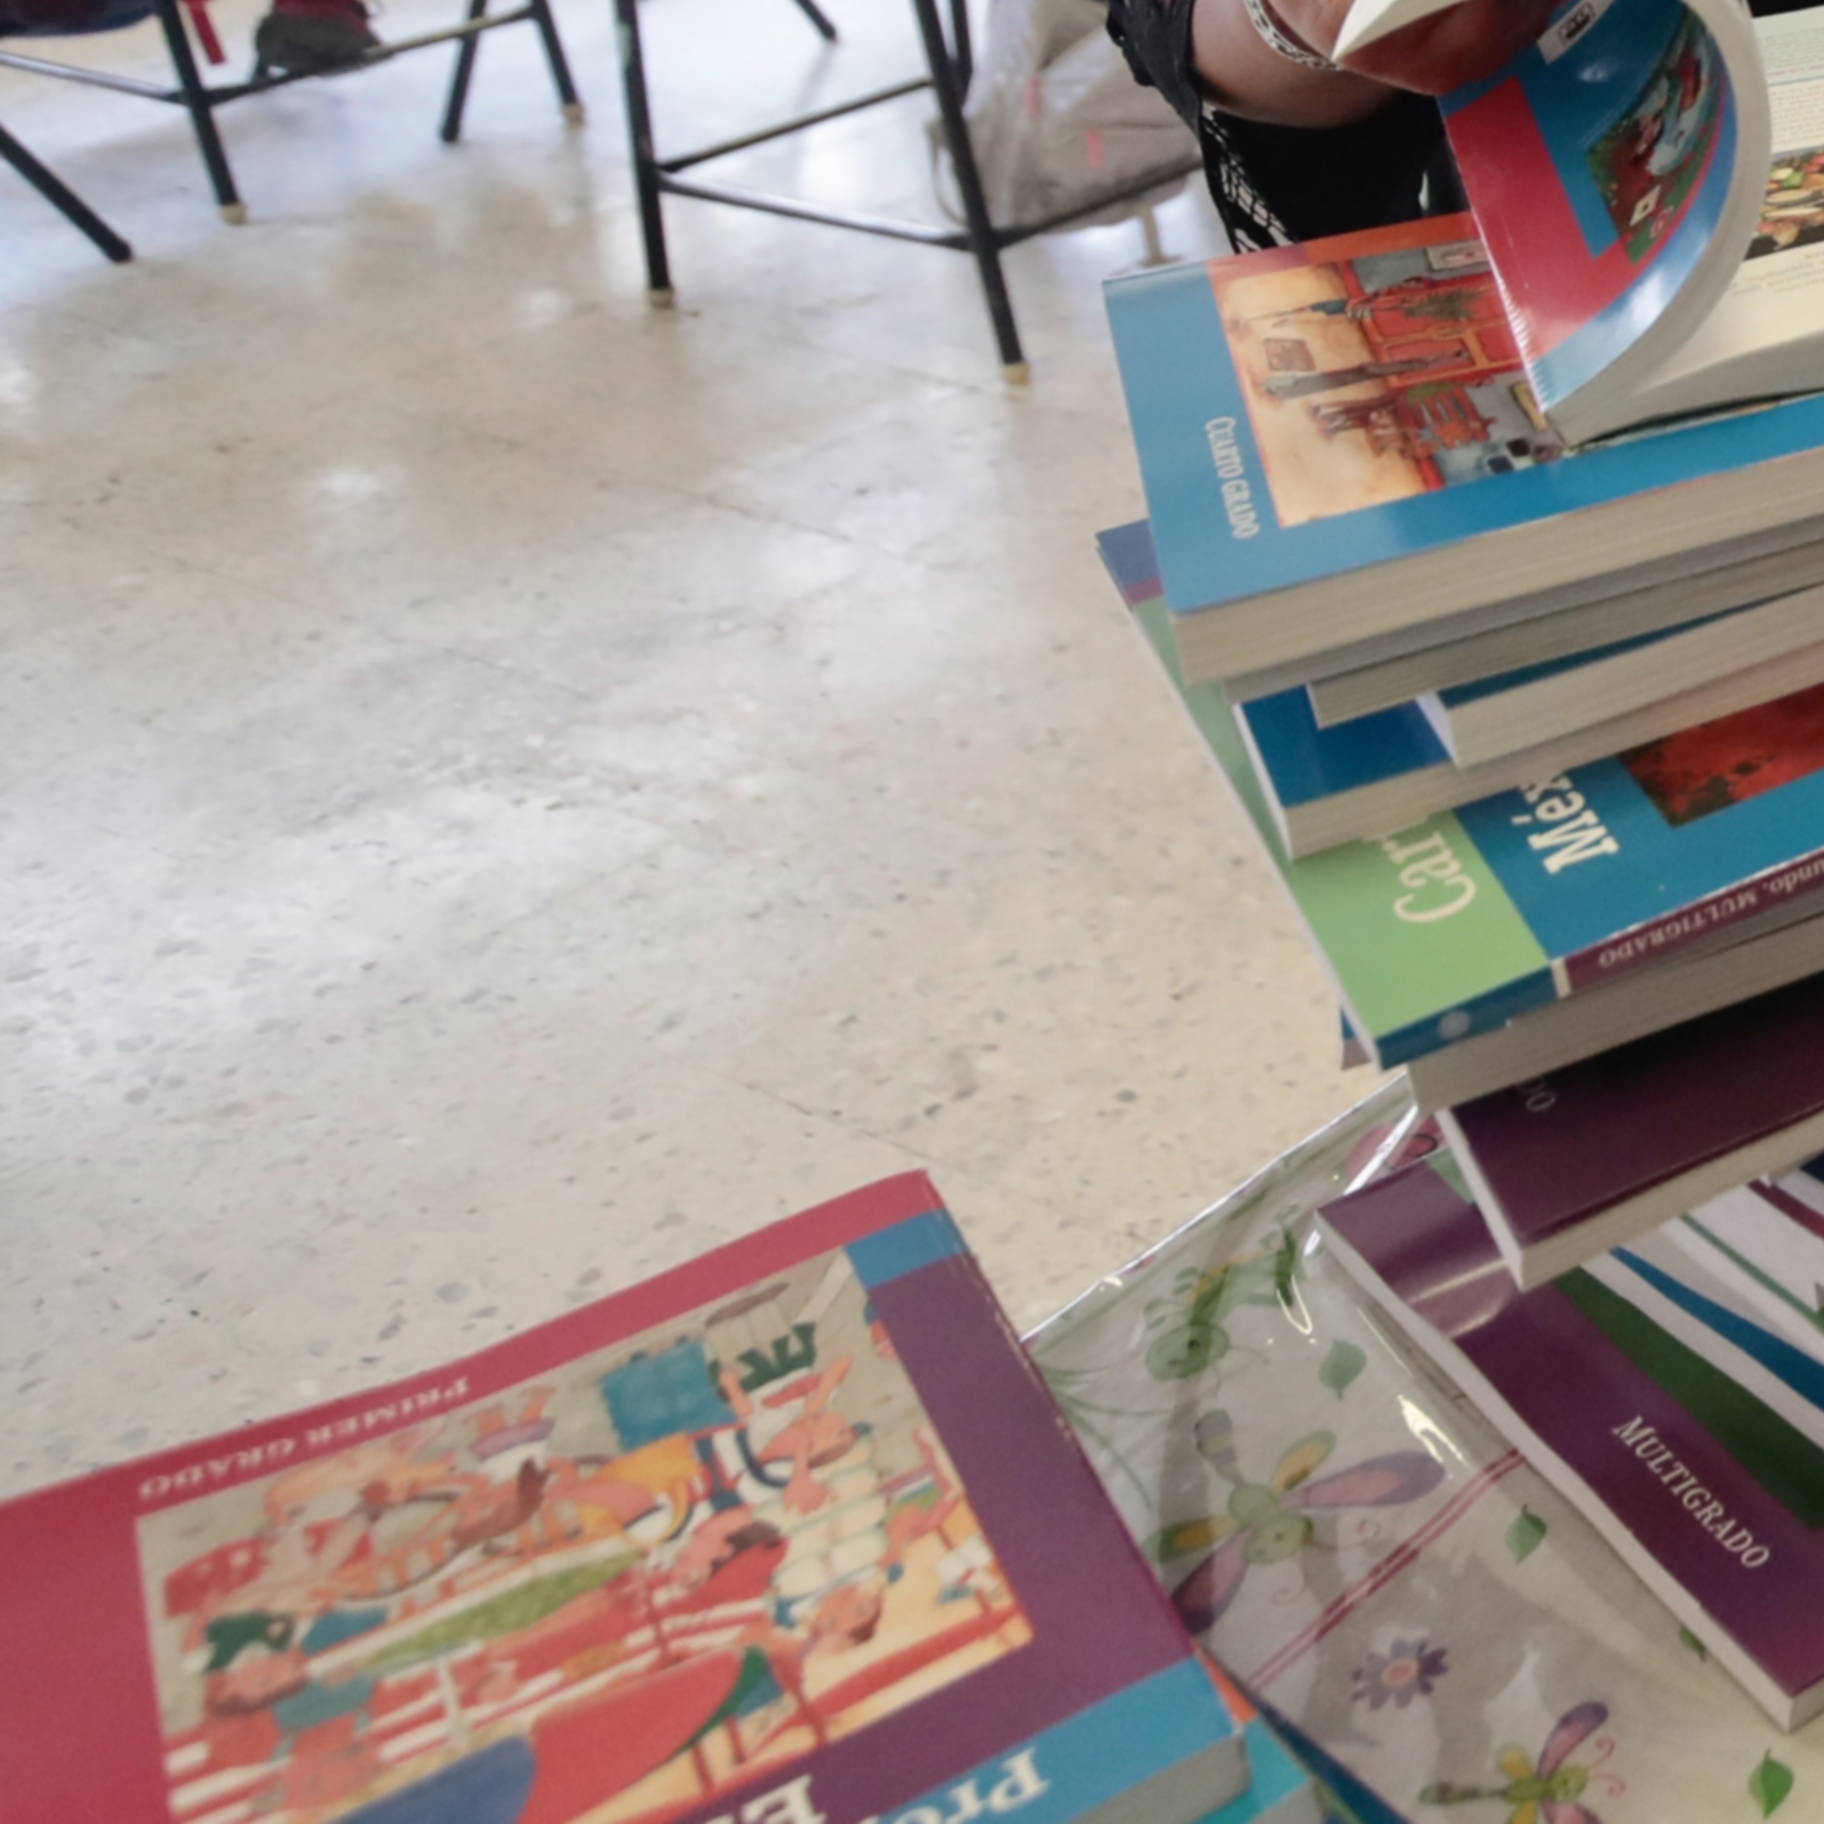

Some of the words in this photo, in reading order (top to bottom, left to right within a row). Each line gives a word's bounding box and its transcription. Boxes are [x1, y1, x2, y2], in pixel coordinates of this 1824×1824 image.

[1204, 416, 1245, 479] CUARTO
[1220, 478, 1261, 539] GRADO
[1599, 888, 1757, 969] MULTIGRADO
[305, 1376, 470, 1446] PRIMER
[137, 1438, 296, 1502] GRADO
[1611, 1414, 1771, 1570] MULTIGRADO
